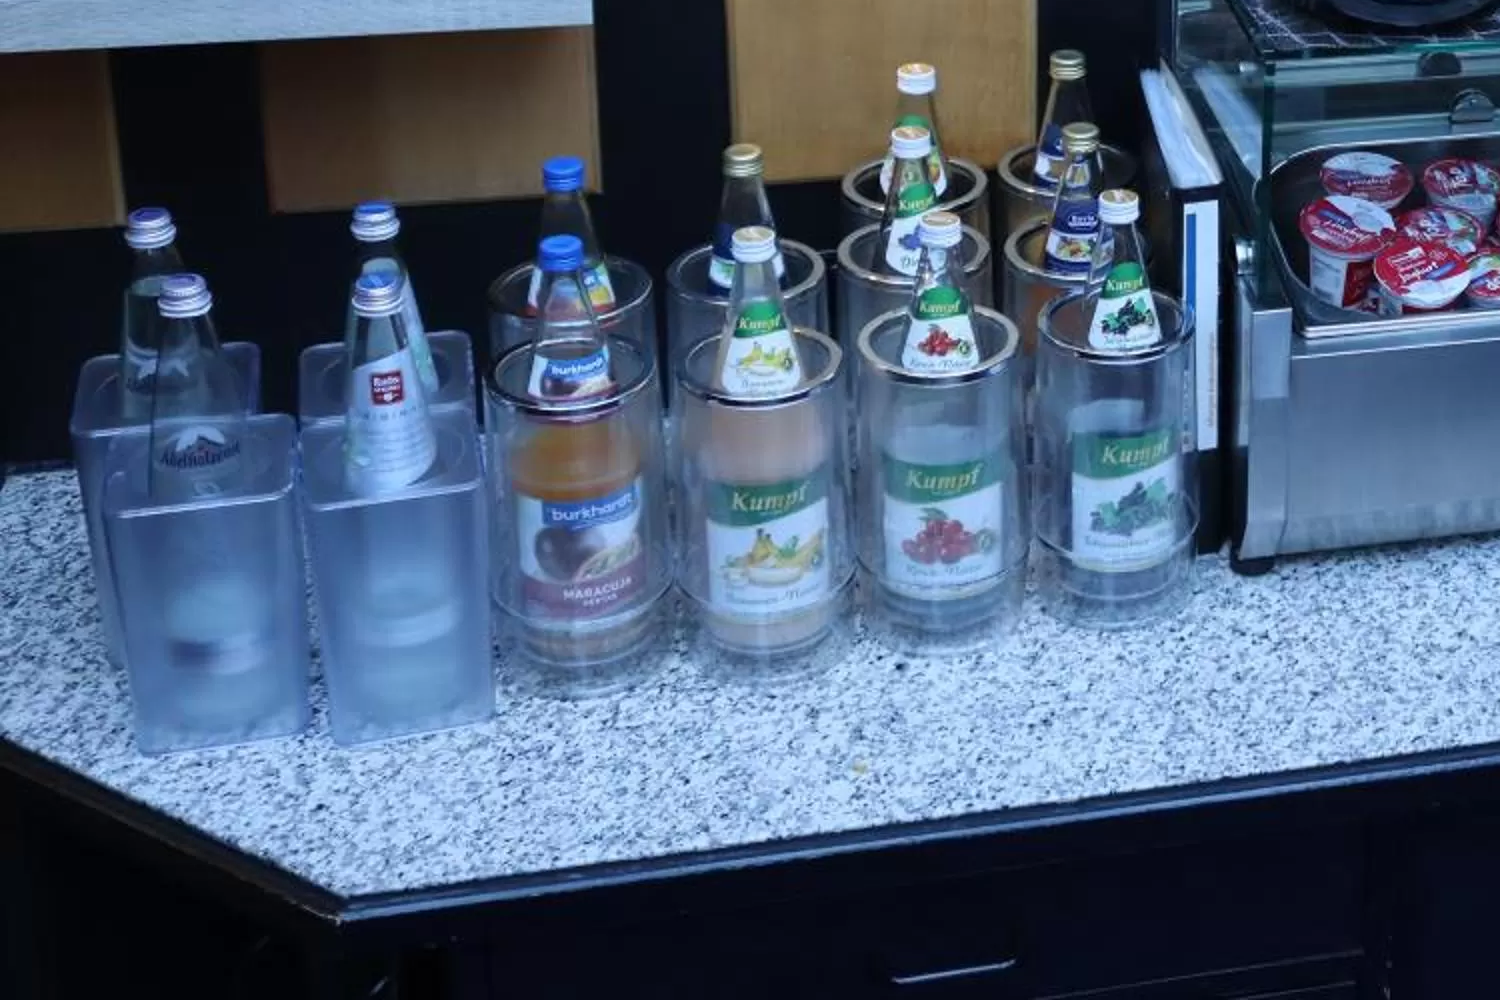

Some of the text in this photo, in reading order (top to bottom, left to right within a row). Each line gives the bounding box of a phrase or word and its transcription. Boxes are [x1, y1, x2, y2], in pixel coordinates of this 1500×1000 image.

[1107, 275, 1144, 293] Kumpf
[919, 300, 960, 315] Kumpf
[738, 313, 782, 331] Kumpf
[1102, 433, 1170, 468] Kumpf
[905, 462, 985, 492] Kumpf
[551, 492, 633, 521] burkhardt
[731, 479, 812, 512] Kumpf
[563, 576, 632, 600] MARACUJA
